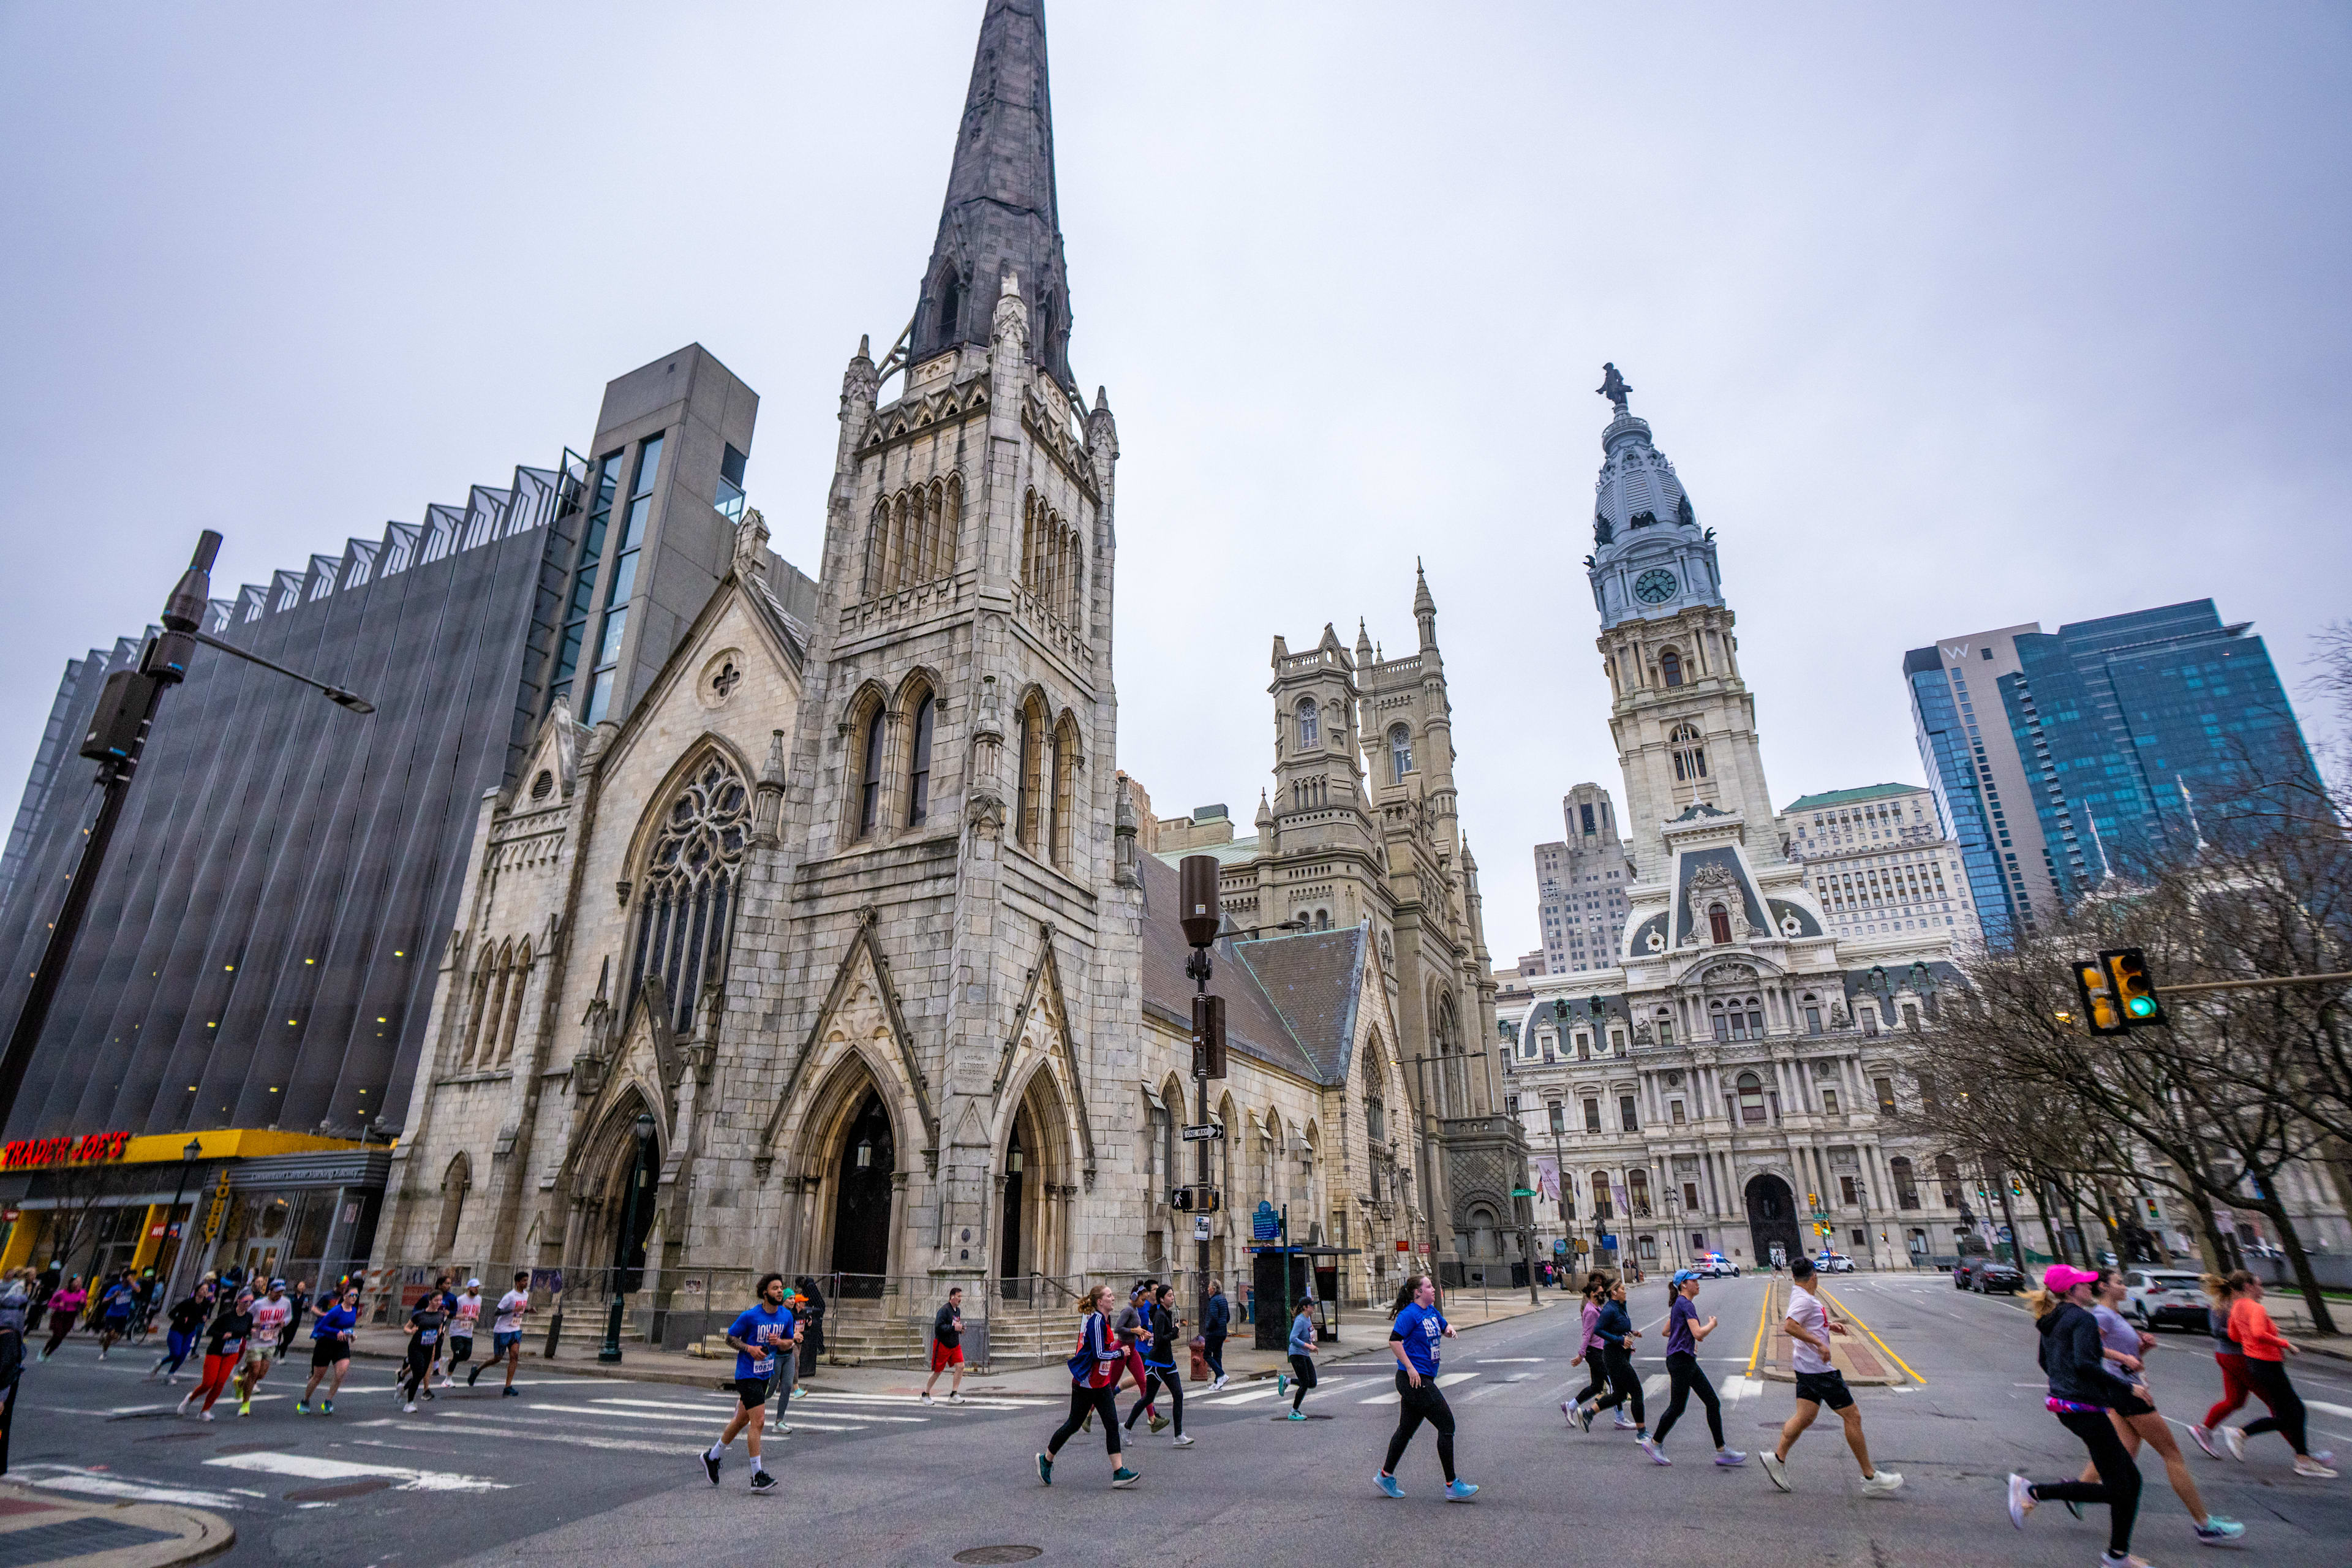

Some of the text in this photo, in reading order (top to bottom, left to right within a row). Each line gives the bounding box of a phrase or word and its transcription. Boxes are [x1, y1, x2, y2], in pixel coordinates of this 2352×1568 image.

[1942, 643, 1969, 660] W
[1, 1131, 129, 1166] TRADER JOE'S
[285, 1170, 307, 1180] Center
[309, 1169, 334, 1180] Parking
[335, 1167, 359, 1179] Facility
[205, 1169, 230, 1244] LOBBY
[152, 1226, 165, 1237] AVIS
